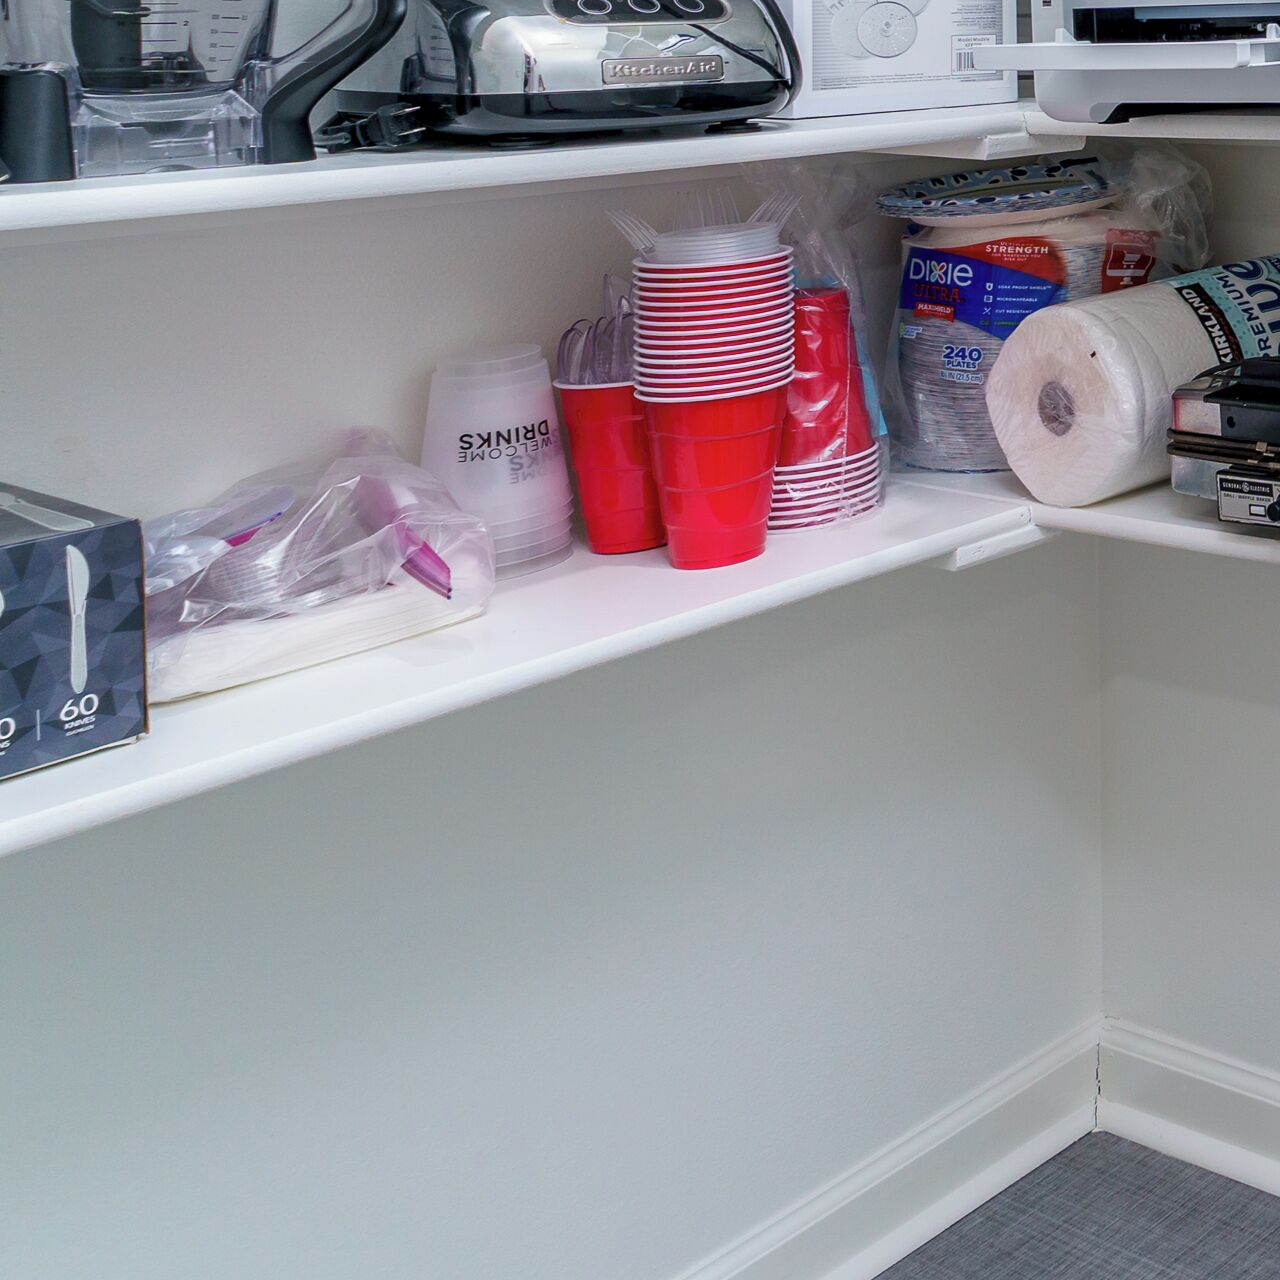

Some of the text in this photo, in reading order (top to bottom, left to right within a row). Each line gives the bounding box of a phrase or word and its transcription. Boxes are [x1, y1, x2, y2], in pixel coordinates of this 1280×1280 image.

[608, 61, 717, 78] KitchenAid
[985, 244, 1049, 255] STRENGTH
[914, 284, 960, 303] ULTRA
[1181, 288, 1235, 364] KIRKLAND
[943, 344, 983, 362] 240
[946, 360, 977, 370] PLATES
[459, 419, 550, 451] DRINKS
[458, 436, 552, 463] WELCOME
[1222, 481, 1270, 493] GENERAL ELECTRIC
[59, 693, 99, 721] 60
[64, 715, 96, 730] KNIVES
